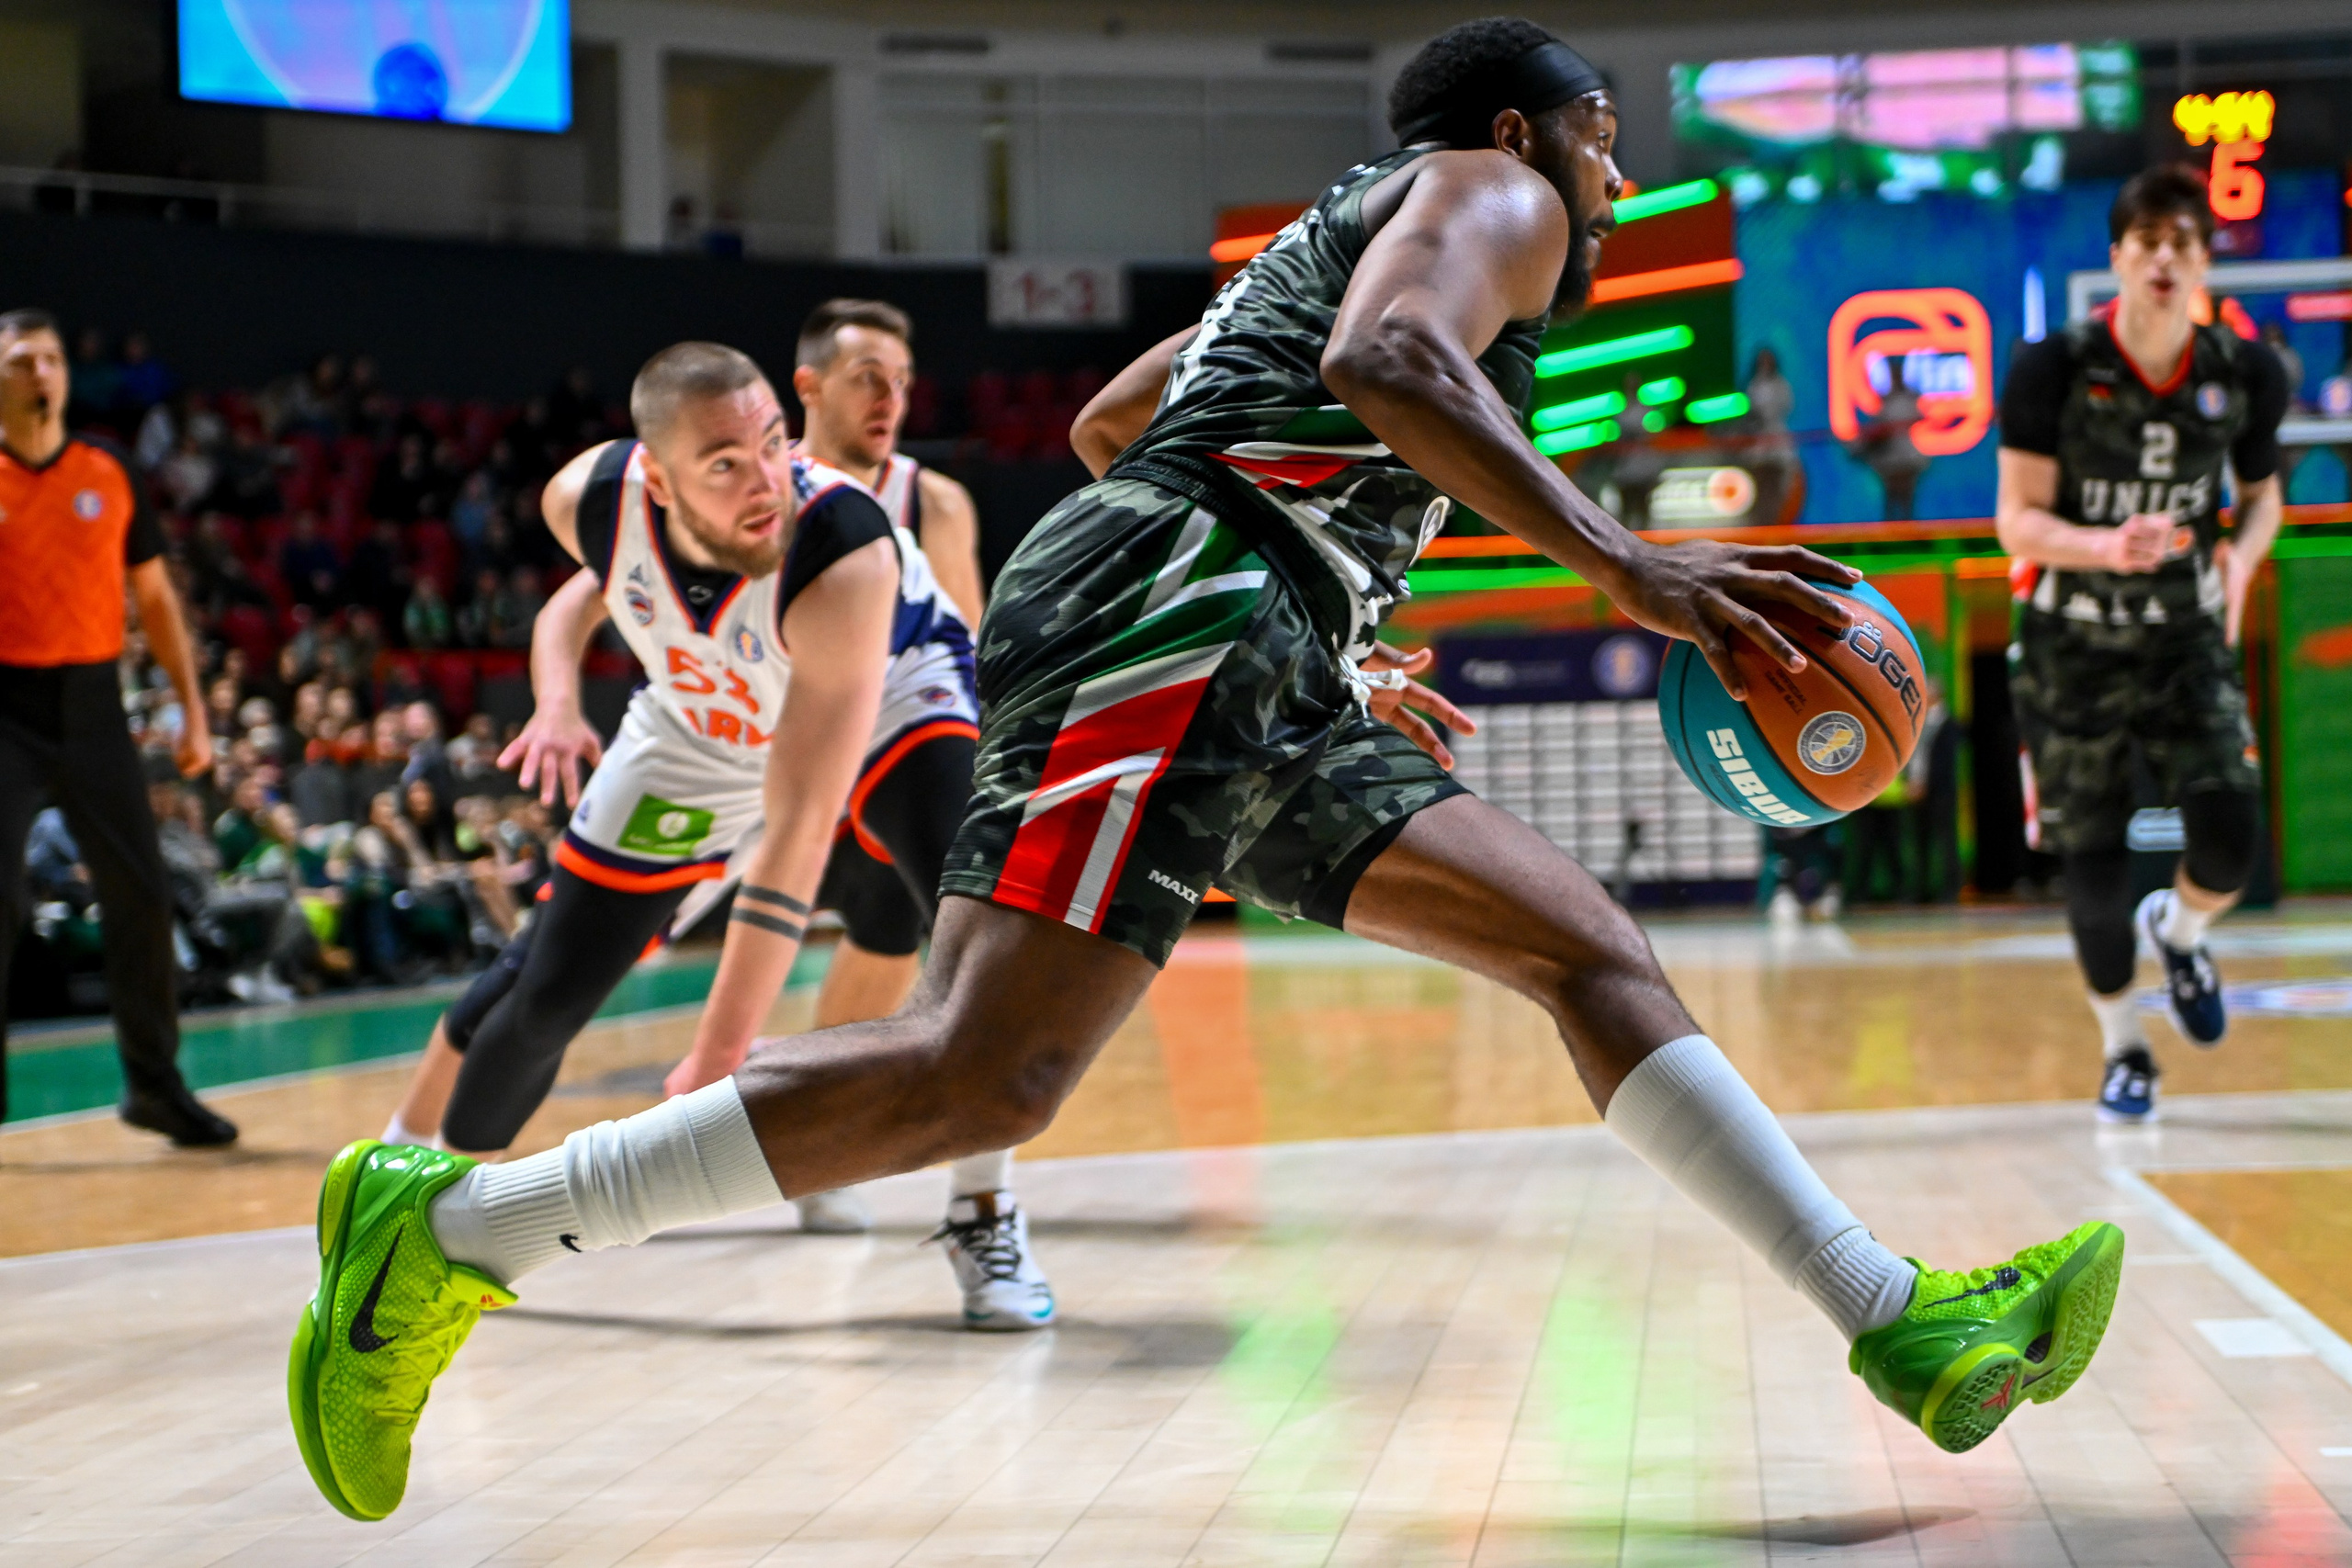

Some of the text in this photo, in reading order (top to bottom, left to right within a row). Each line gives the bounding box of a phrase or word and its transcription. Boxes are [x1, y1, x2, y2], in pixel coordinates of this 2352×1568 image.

[2208, 141, 2266, 221] 6
[2139, 421, 2177, 479] 2
[1706, 728, 1812, 824] SIBUR
[1148, 869, 1199, 905] MAXX
